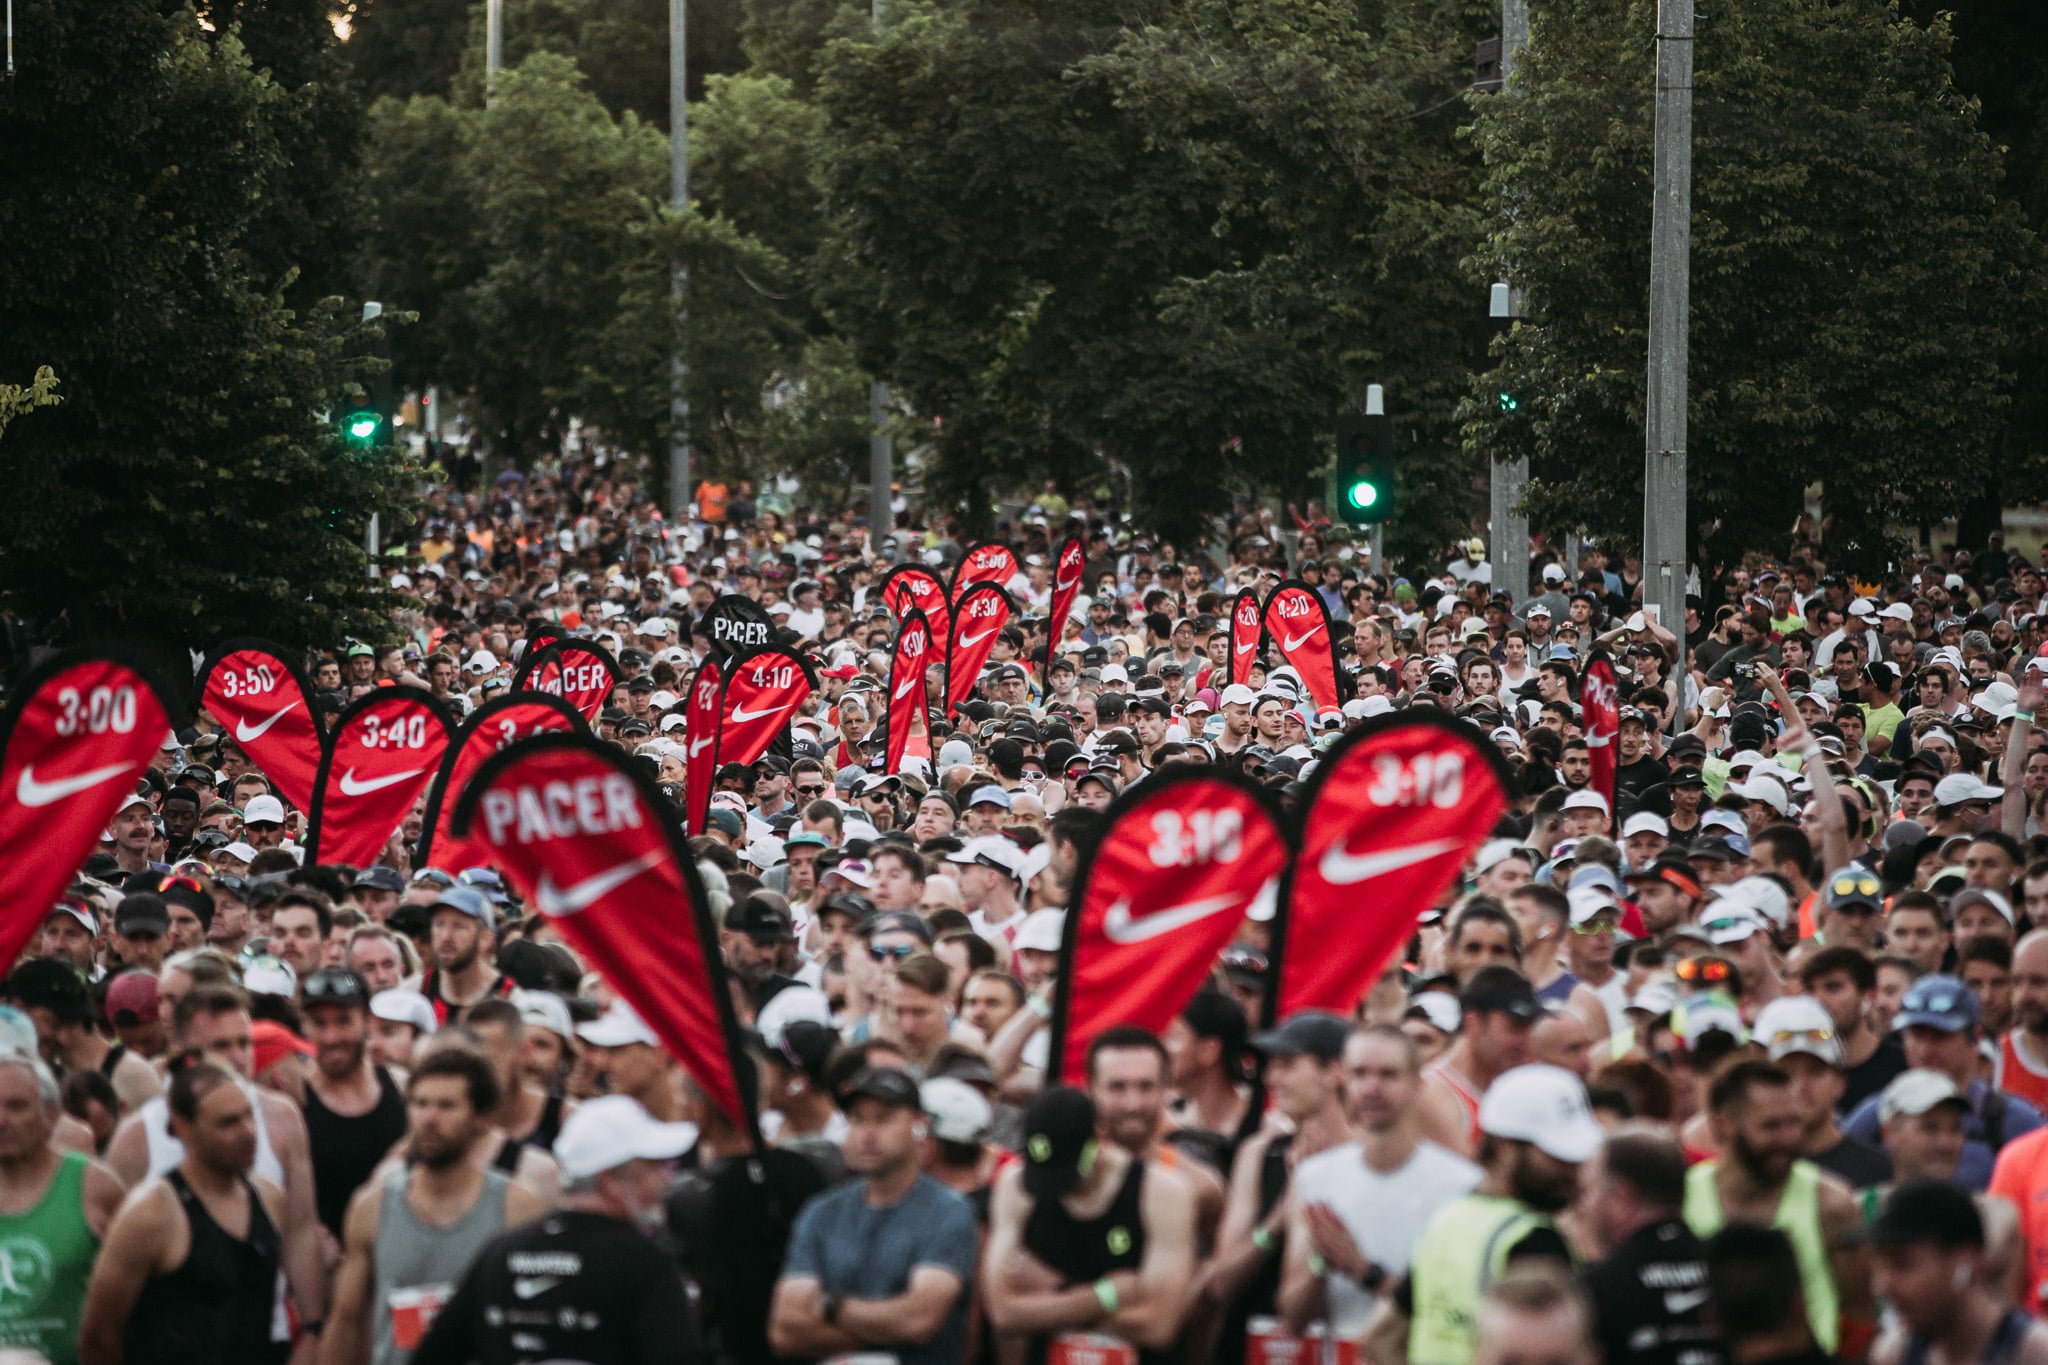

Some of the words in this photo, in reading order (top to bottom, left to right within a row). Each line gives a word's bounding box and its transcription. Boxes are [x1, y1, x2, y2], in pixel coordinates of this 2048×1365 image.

[977, 554, 1007, 569] 5:00
[970, 597, 998, 617] 4:30
[1238, 606, 1257, 626] 4:20
[1278, 595, 1309, 619] 4:20
[714, 617, 768, 645] PACER
[222, 664, 274, 698] 3:50
[751, 666, 792, 689] 4:10
[55, 686, 136, 736] 3:00
[361, 715, 426, 749] 3:40
[1368, 751, 1466, 810] 3:10
[481, 771, 643, 846] PACER
[1147, 808, 1243, 869] 3:10
